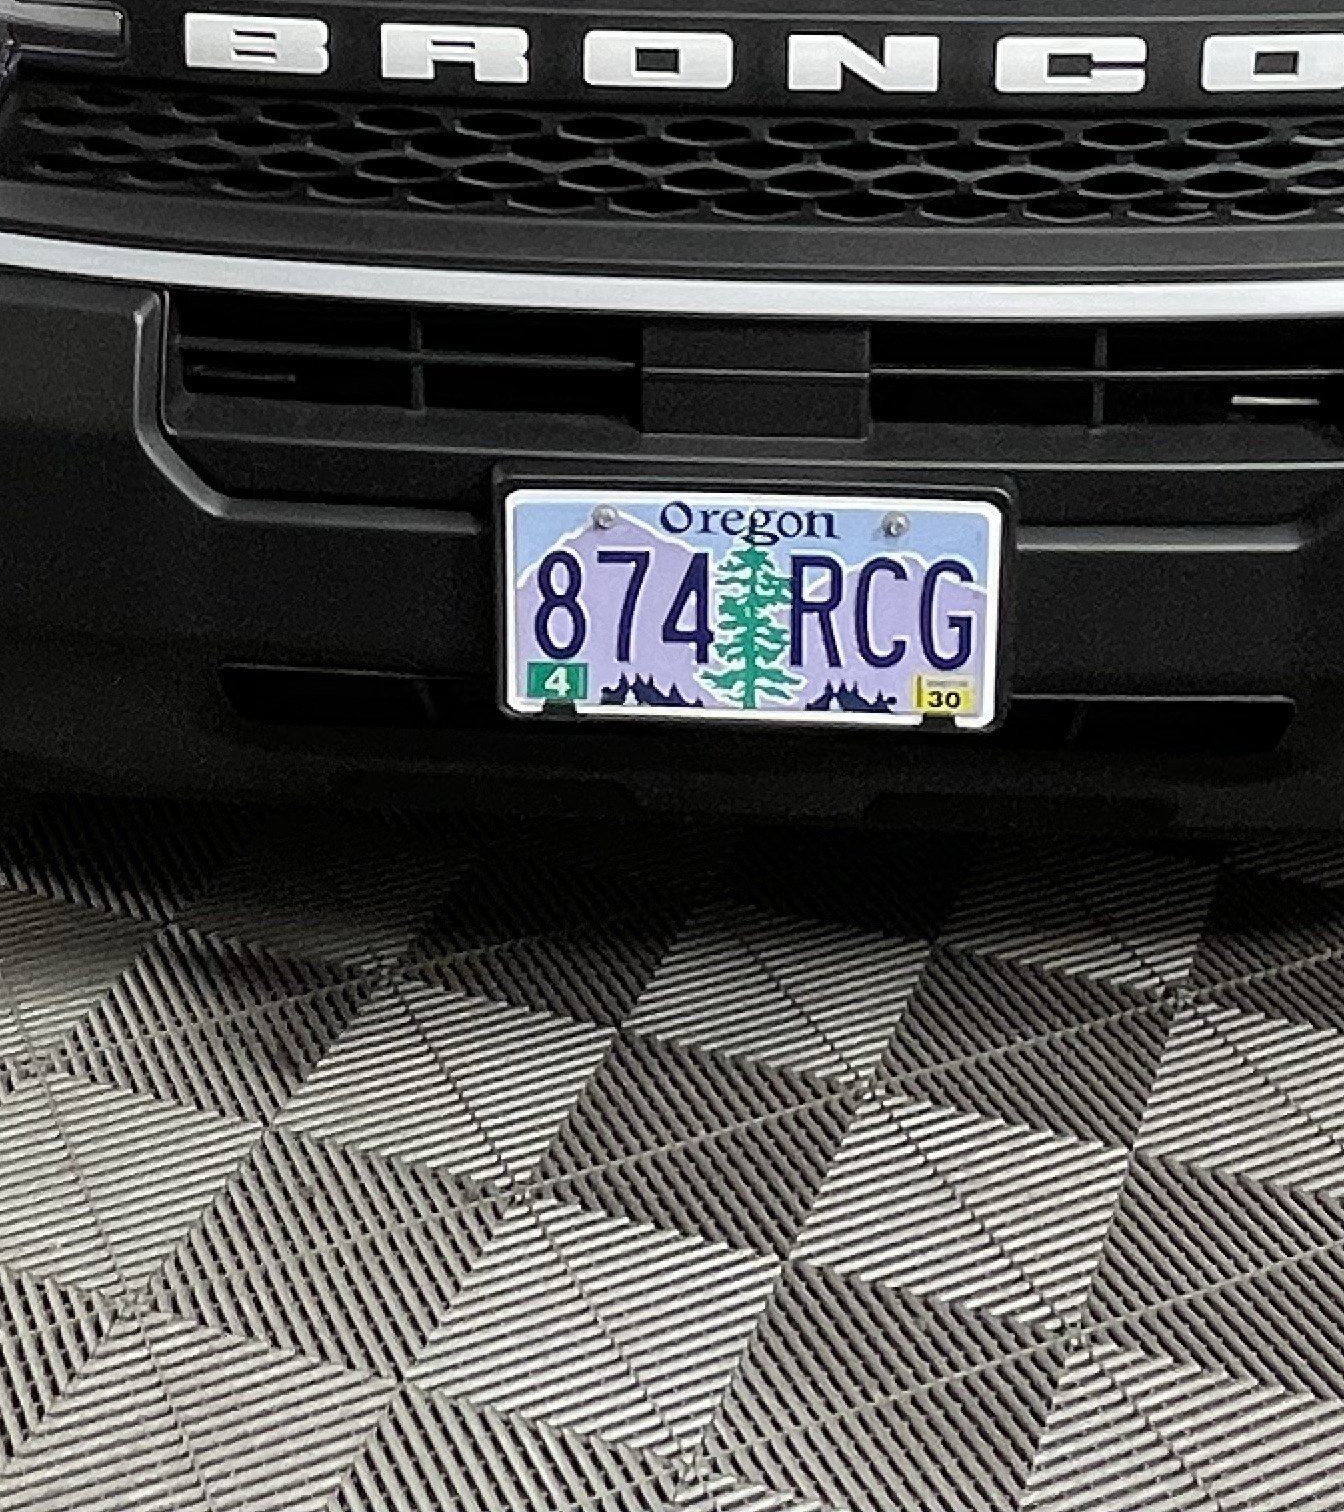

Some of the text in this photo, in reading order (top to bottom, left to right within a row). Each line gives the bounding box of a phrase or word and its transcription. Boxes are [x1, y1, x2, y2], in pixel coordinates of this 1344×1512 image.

[659, 500, 841, 546] Oregon
[534, 549, 976, 671] 874 RCG
[544, 666, 572, 697] 4
[927, 690, 962, 709] 30
